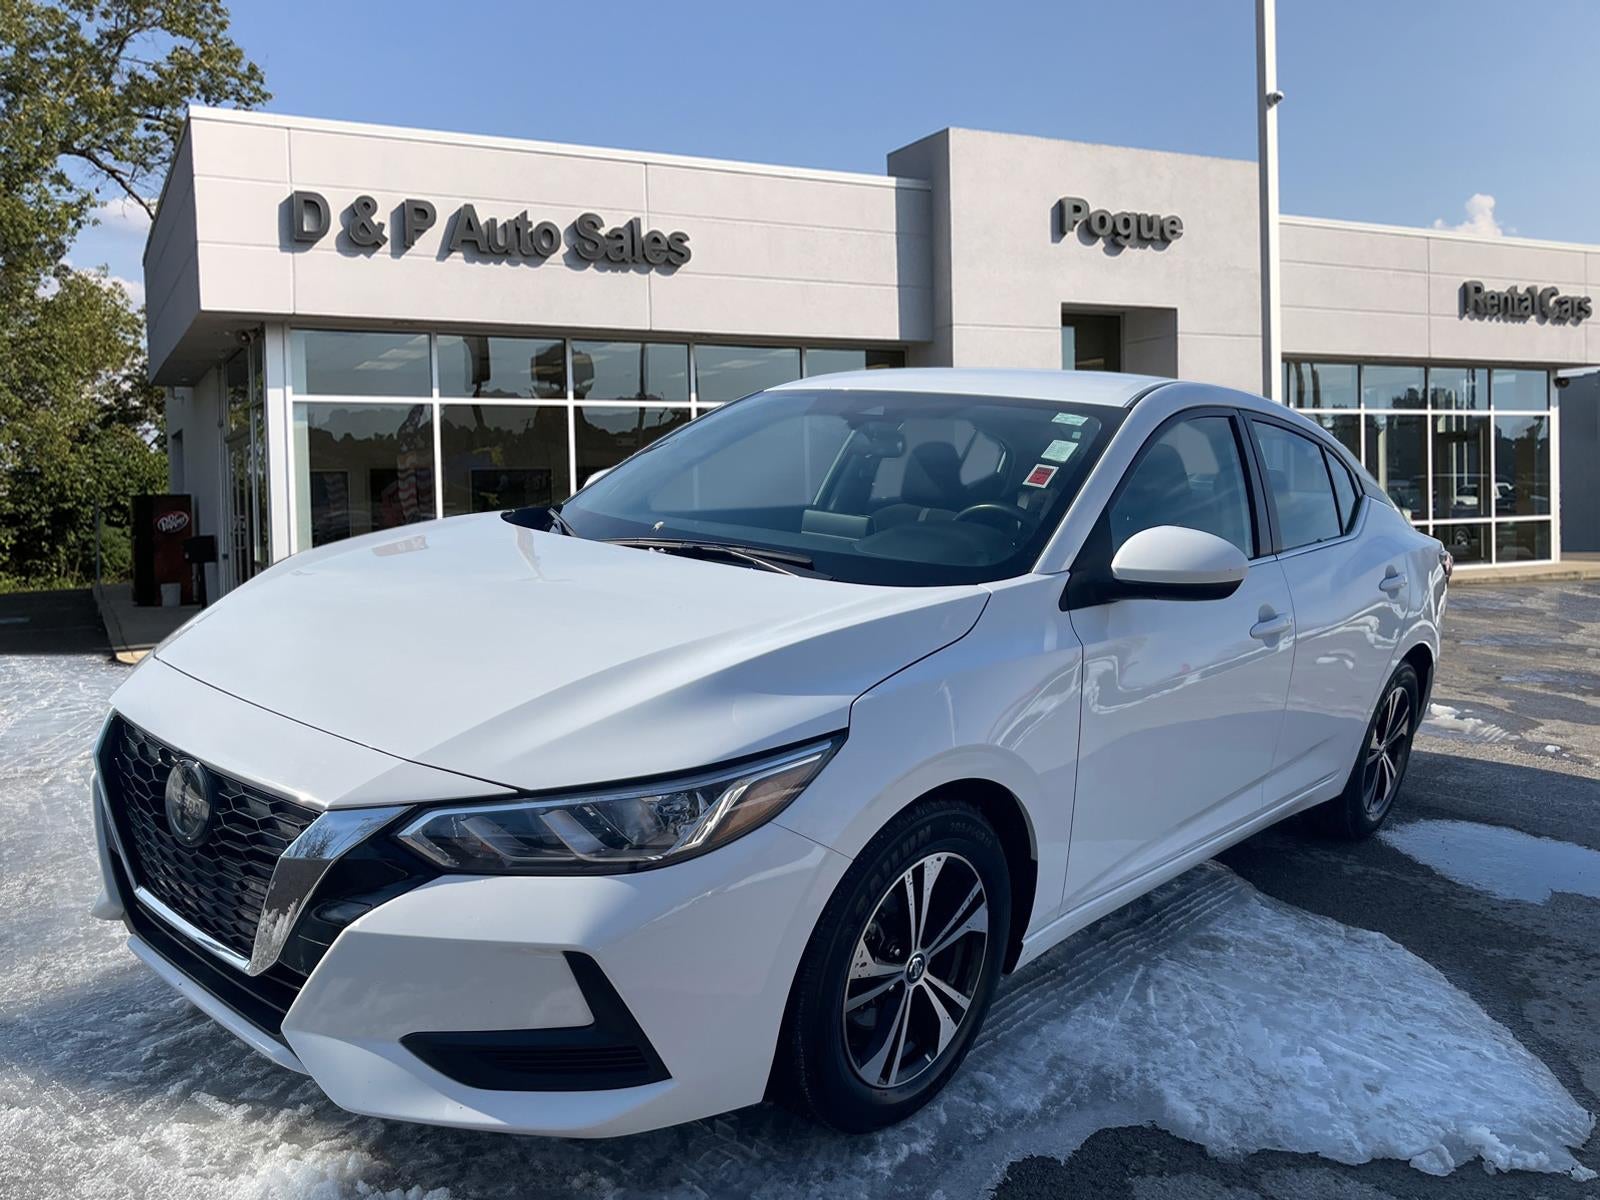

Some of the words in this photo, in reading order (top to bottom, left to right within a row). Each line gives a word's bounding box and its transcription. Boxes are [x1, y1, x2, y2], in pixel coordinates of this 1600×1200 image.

[293, 190, 331, 243] D
[350, 195, 388, 247] &
[403, 199, 437, 249] P
[448, 203, 561, 257] Auto
[571, 212, 692, 266] Sales
[1058, 196, 1183, 247] Pogue
[1463, 280, 1538, 319] Rental
[1539, 286, 1592, 322] Cars
